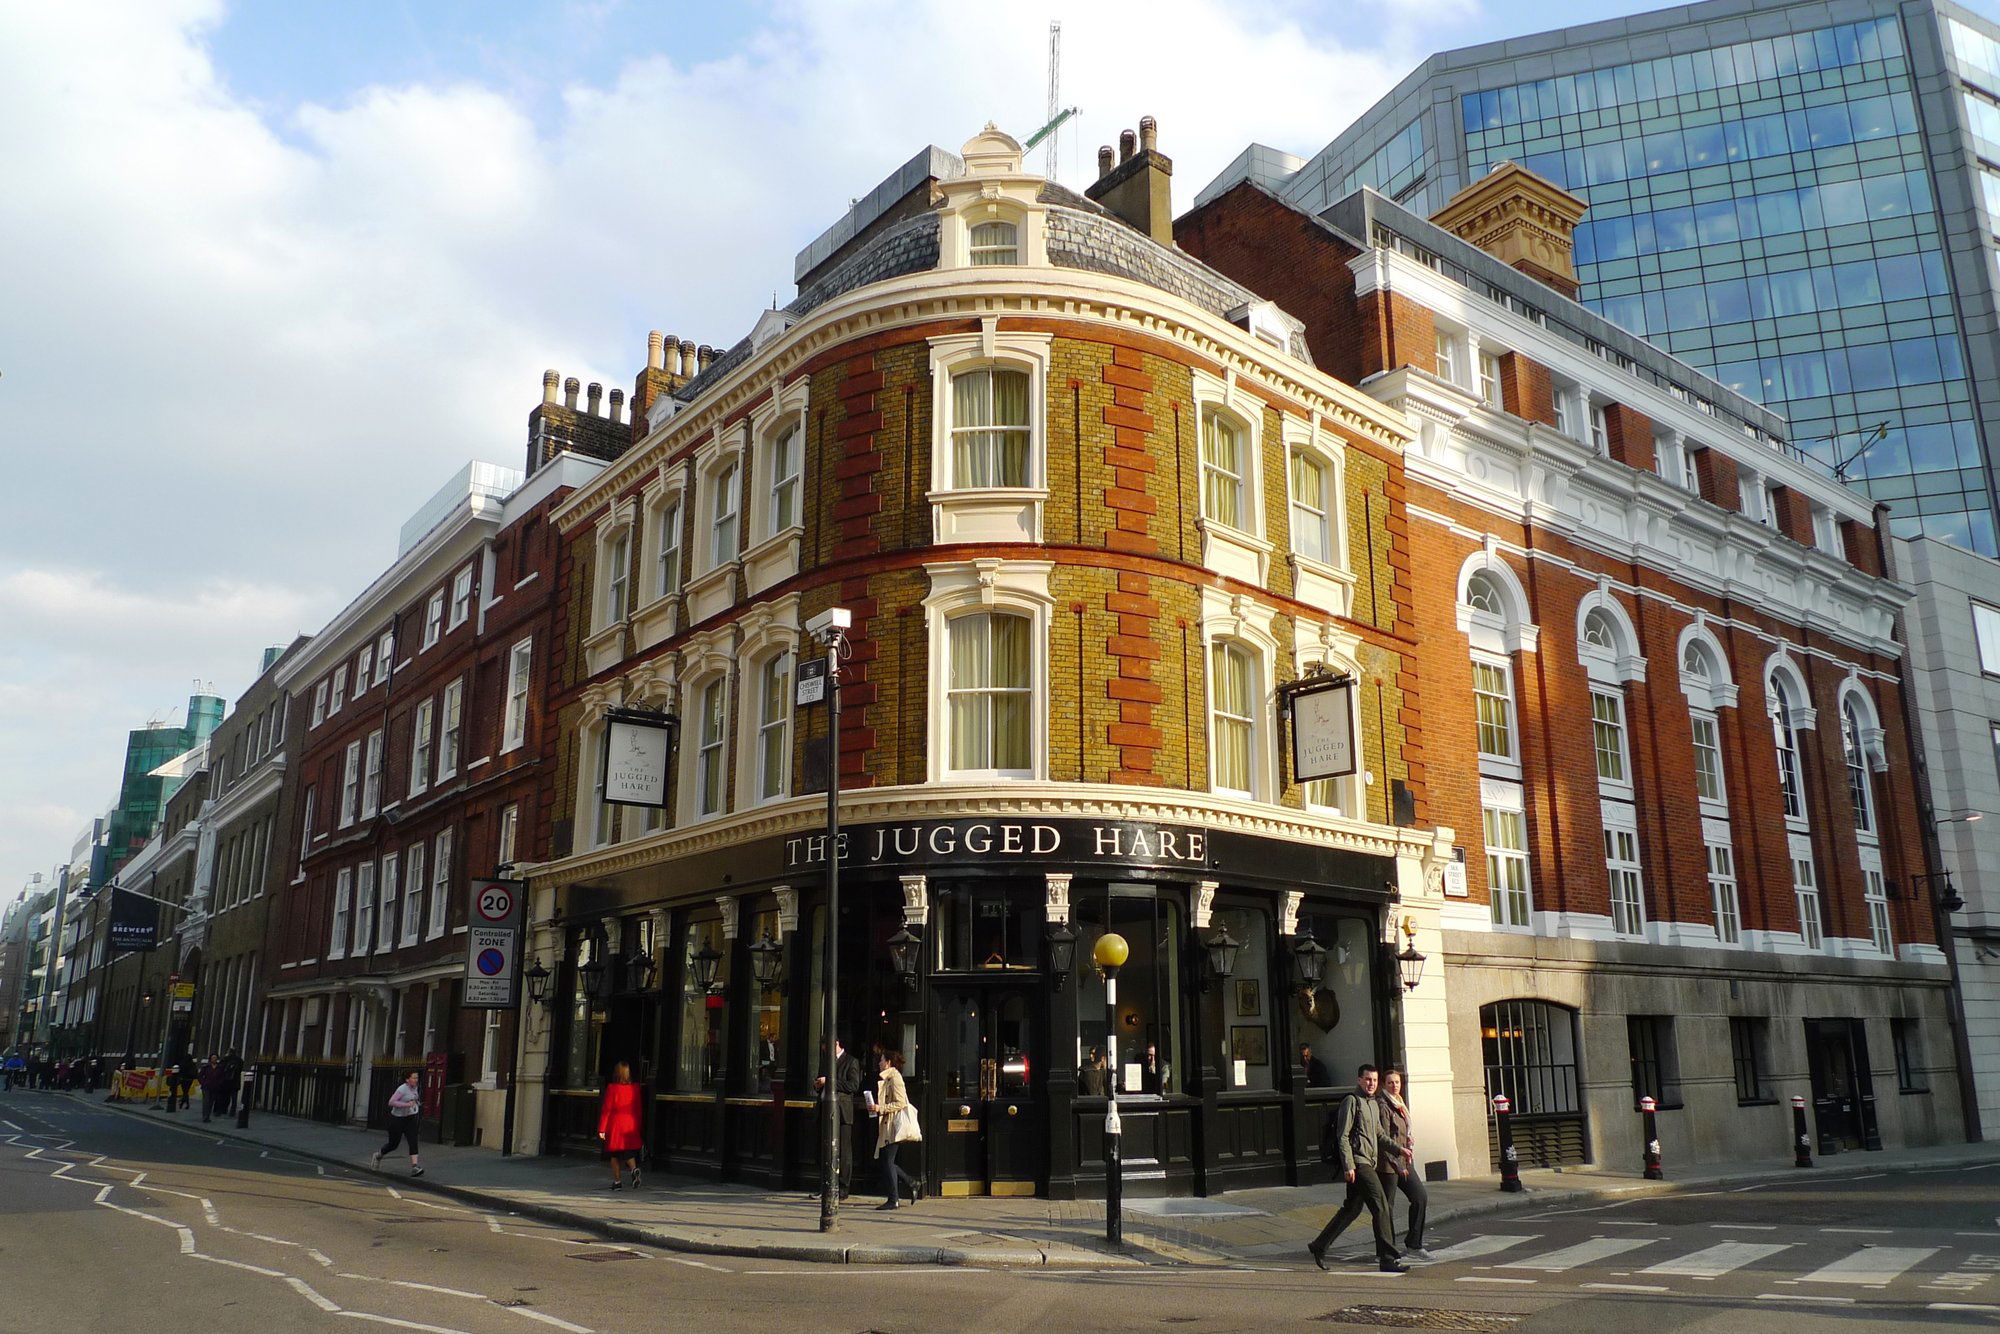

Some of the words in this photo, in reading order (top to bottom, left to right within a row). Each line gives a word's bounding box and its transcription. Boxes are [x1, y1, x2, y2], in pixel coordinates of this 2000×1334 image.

[1303, 742, 1344, 758] JUGGED
[1310, 753, 1339, 764] HARE
[614, 772, 658, 783] JUGGED
[621, 782, 651, 792] HARE
[786, 832, 849, 866] THE
[871, 824, 1061, 861] JUGGED
[1093, 827, 1205, 861] HARE
[484, 896, 508, 912] 20
[478, 938, 505, 946] ZONE
